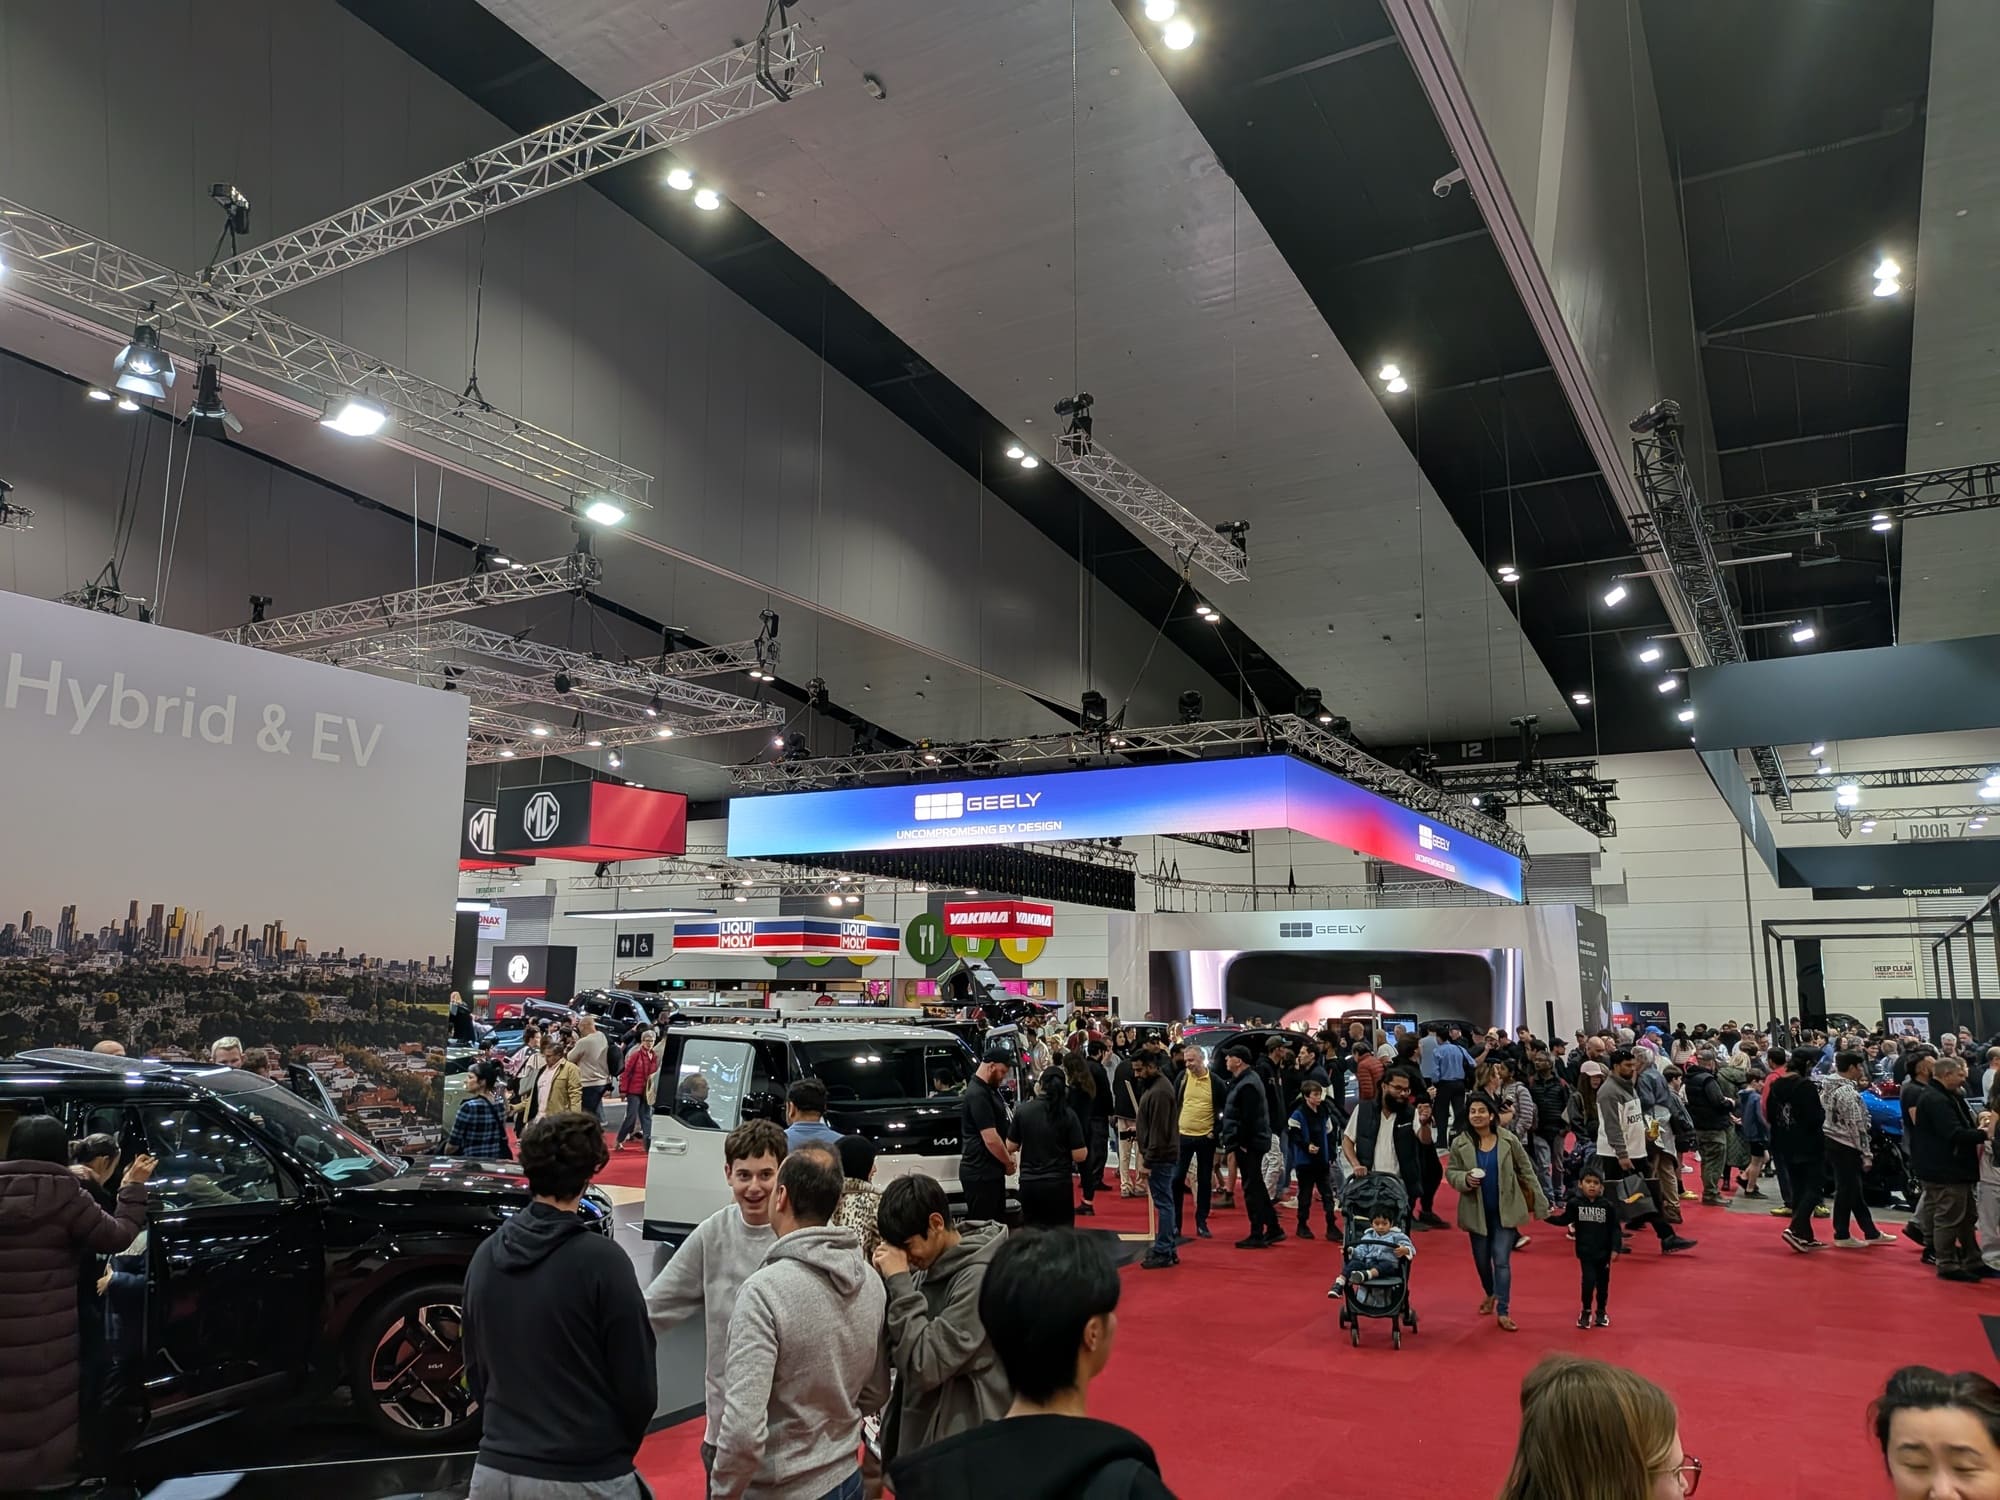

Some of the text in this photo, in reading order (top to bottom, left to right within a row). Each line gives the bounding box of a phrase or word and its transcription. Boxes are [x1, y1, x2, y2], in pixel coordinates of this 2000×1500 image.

[5, 652, 384, 768] Hybrid & EV
[1461, 742, 1483, 758] 12
[966, 792, 1042, 812] GEELY
[527, 796, 558, 838] MG
[896, 821, 1062, 840] UNCOMPROMISING BY DESIGN
[1909, 822, 1966, 838] DOOR 7
[1902, 886, 1965, 896] Open your mind.
[950, 911, 1009, 925] YAKIMA
[1016, 912, 1052, 927] YAKIMA
[721, 921, 752, 935] LIQUI
[842, 923, 865, 937] LIQUI
[1315, 925, 1366, 934] GEELY
[721, 935, 752, 948] MOLY
[842, 936, 865, 949] MOLY
[1578, 1206, 1606, 1217] KINGS
